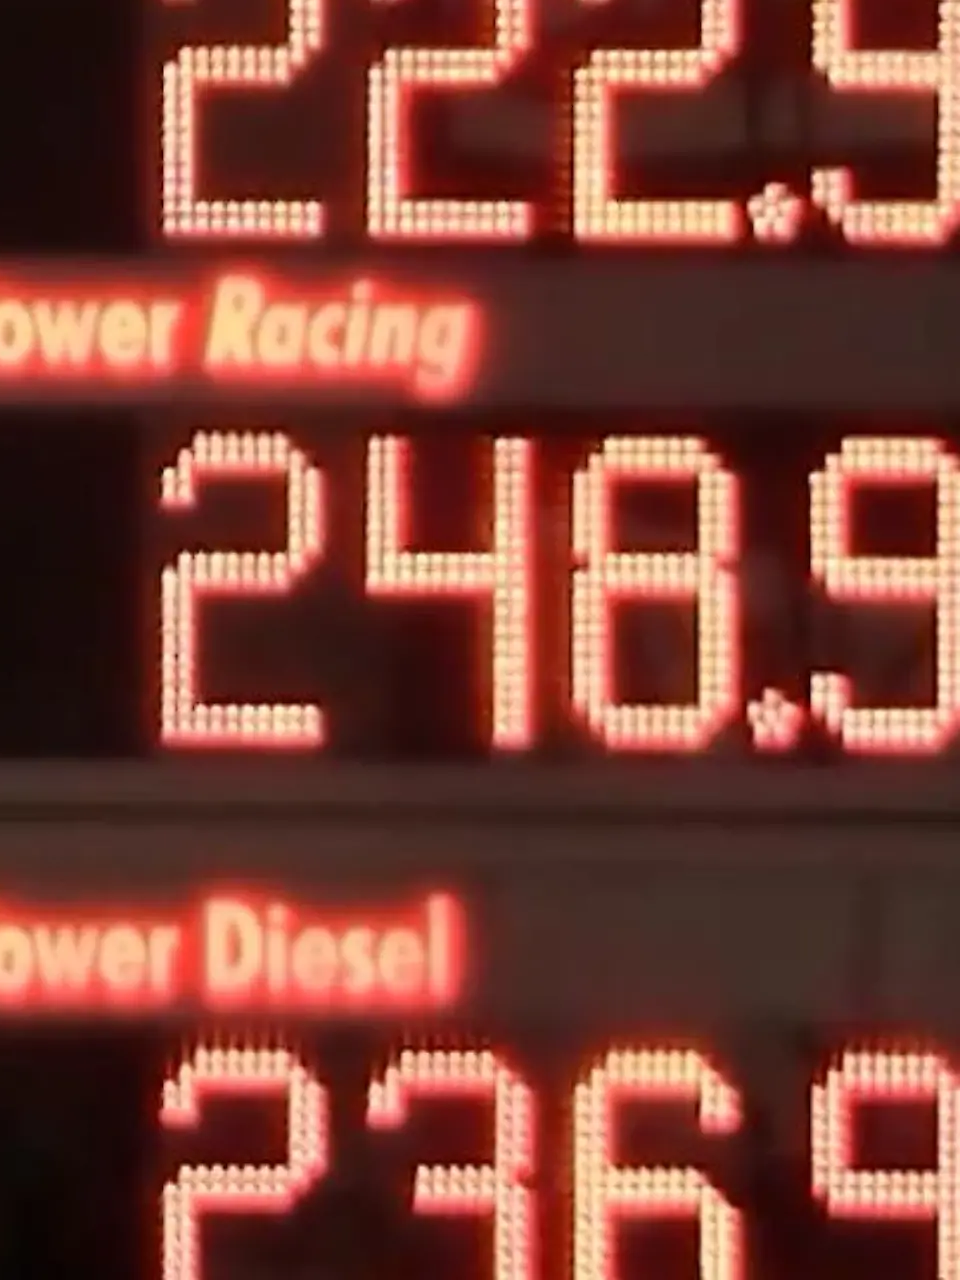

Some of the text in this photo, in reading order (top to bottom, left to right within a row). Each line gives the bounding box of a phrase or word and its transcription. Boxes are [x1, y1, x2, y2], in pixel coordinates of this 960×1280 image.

[202, 273, 472, 394] Racing
[160, 432, 960, 749] 248.9
[201, 893, 452, 998] Diesel
